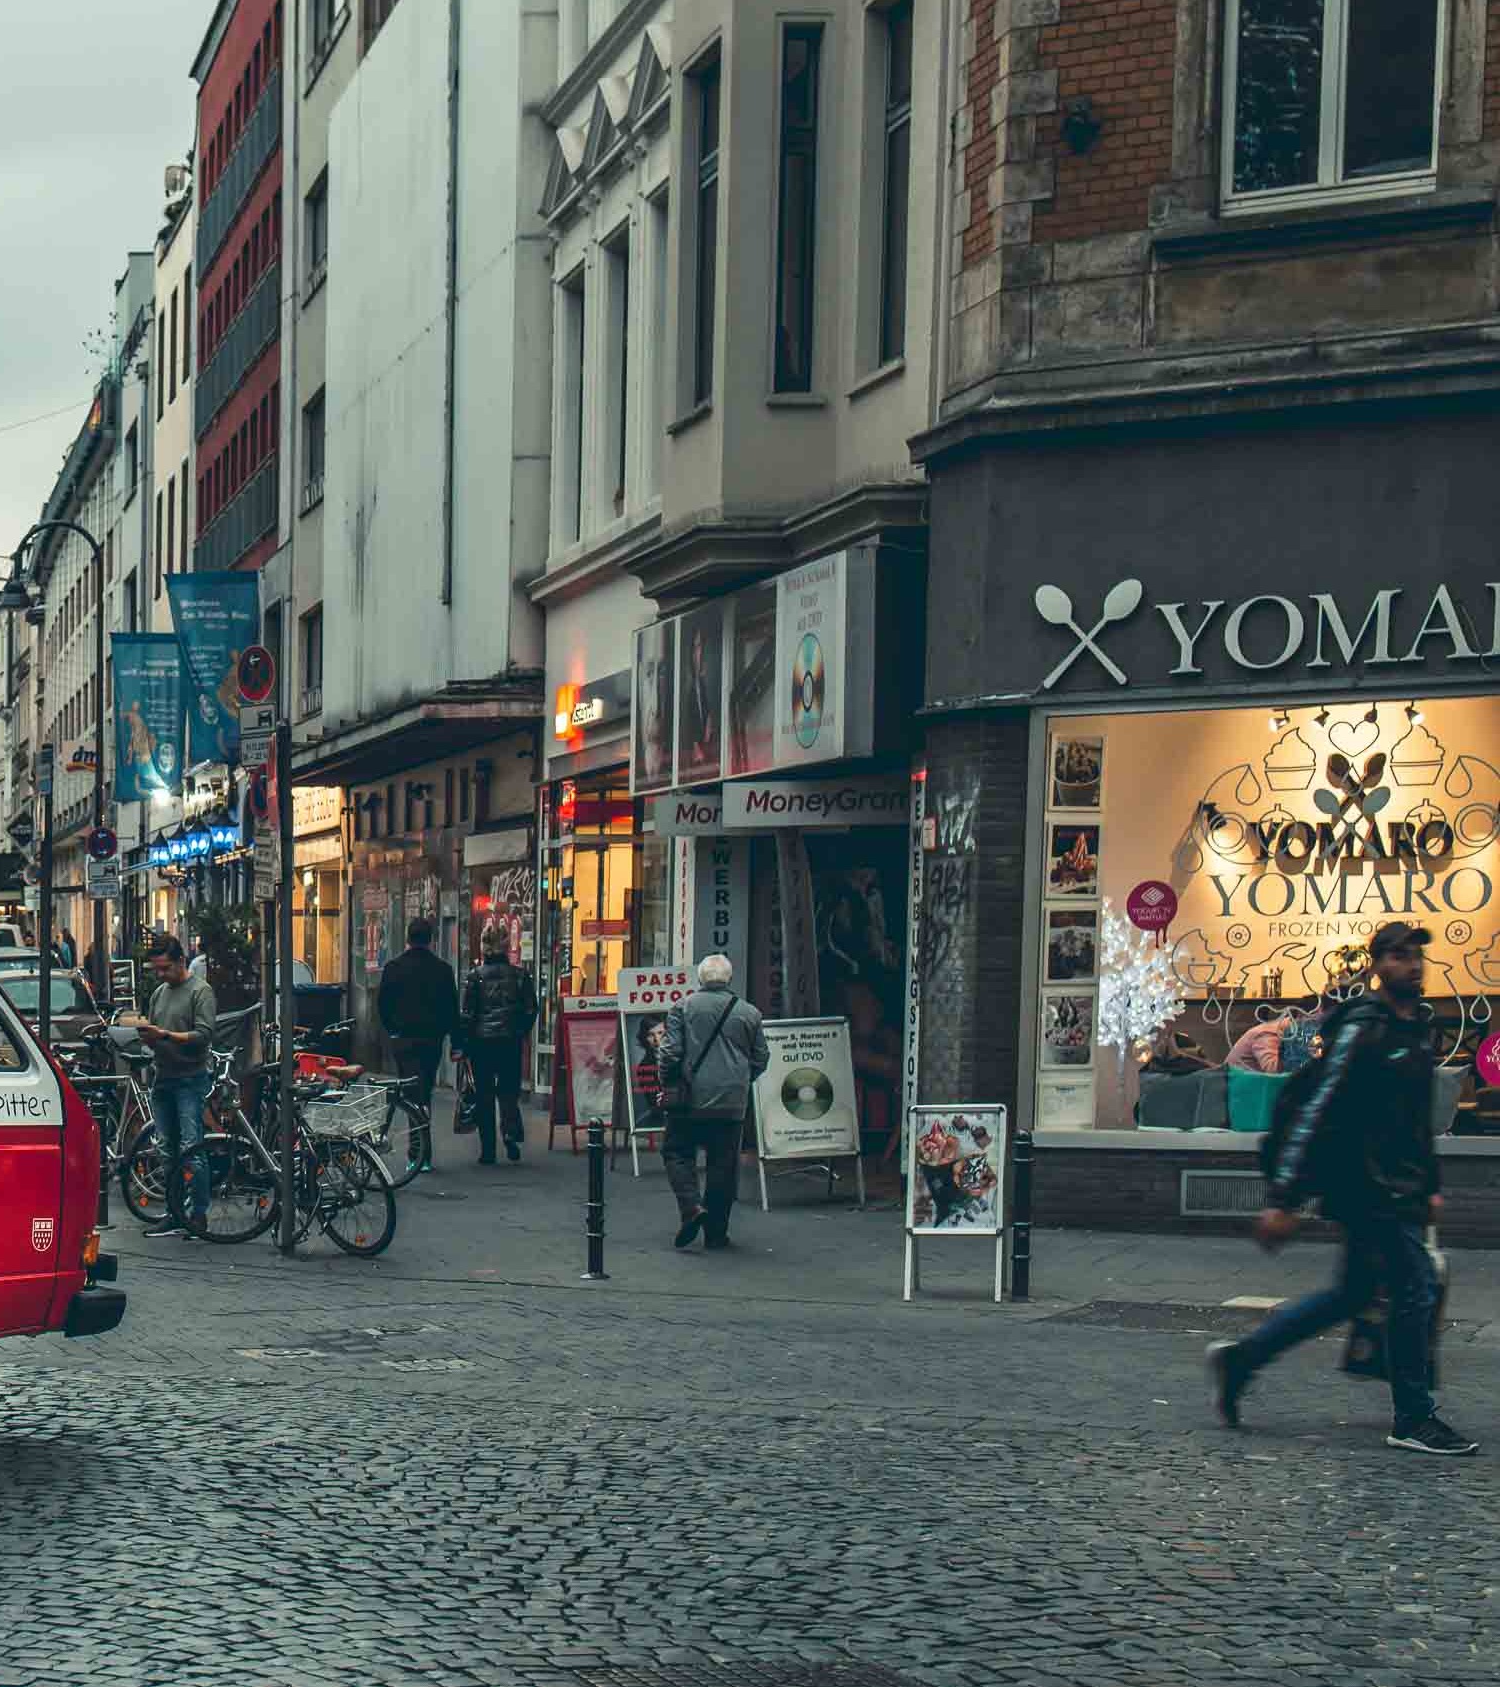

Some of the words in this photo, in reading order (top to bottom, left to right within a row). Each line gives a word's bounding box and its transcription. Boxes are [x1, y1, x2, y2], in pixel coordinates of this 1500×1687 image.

[1154, 582, 1500, 674] YOMA
[1247, 820, 1454, 860] YOMARO
[1209, 866, 1493, 917] YOMARO
[1269, 921, 1341, 937] FROZEN
[636, 972, 687, 987] PASS
[782, 1053, 799, 1063] auf
[802, 1052, 824, 1062] DVD
